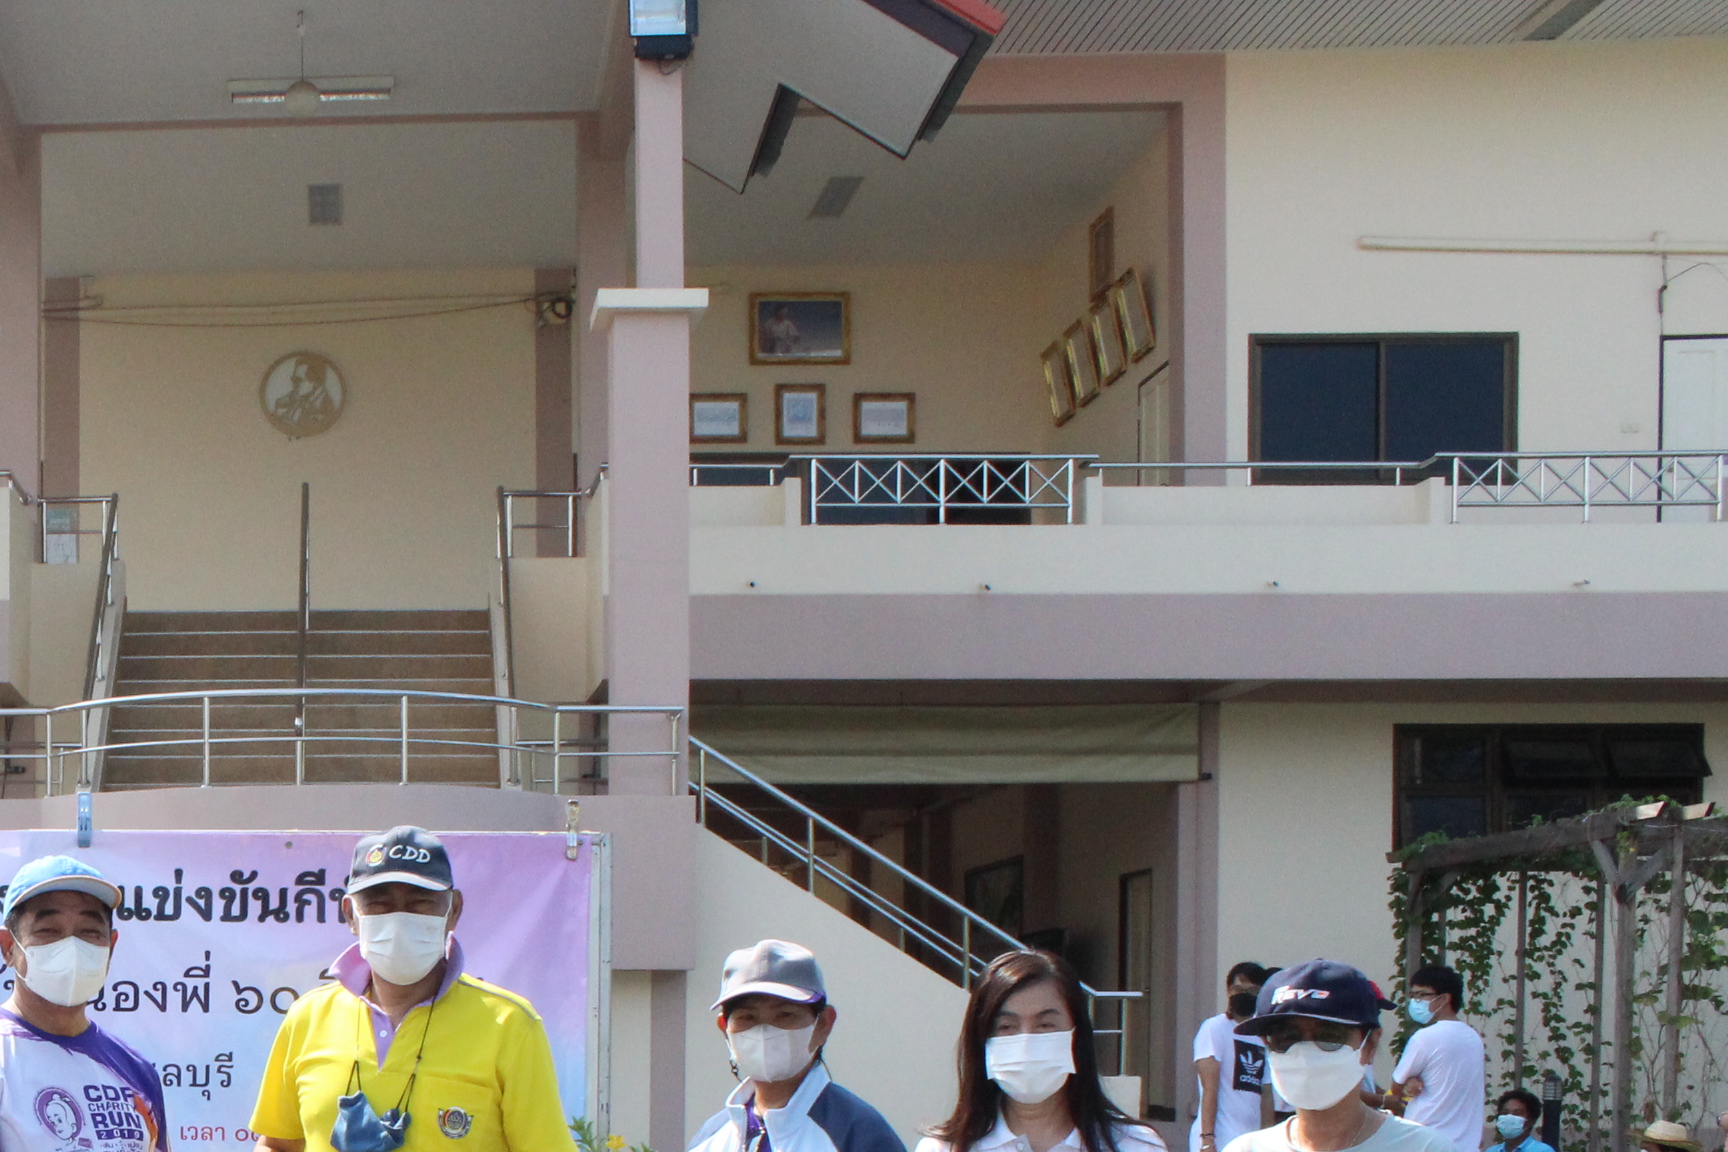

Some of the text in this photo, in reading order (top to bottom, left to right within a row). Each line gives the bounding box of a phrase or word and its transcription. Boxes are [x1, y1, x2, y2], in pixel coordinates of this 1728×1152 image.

[389, 845, 431, 863] CDD
[153, 1051, 234, 1101] ลบุรี
[83, 1084, 135, 1102] CDF
[87, 1101, 136, 1113] CHARITY
[90, 1111, 143, 1130] RUN
[99, 1130, 140, 1139] 2019
